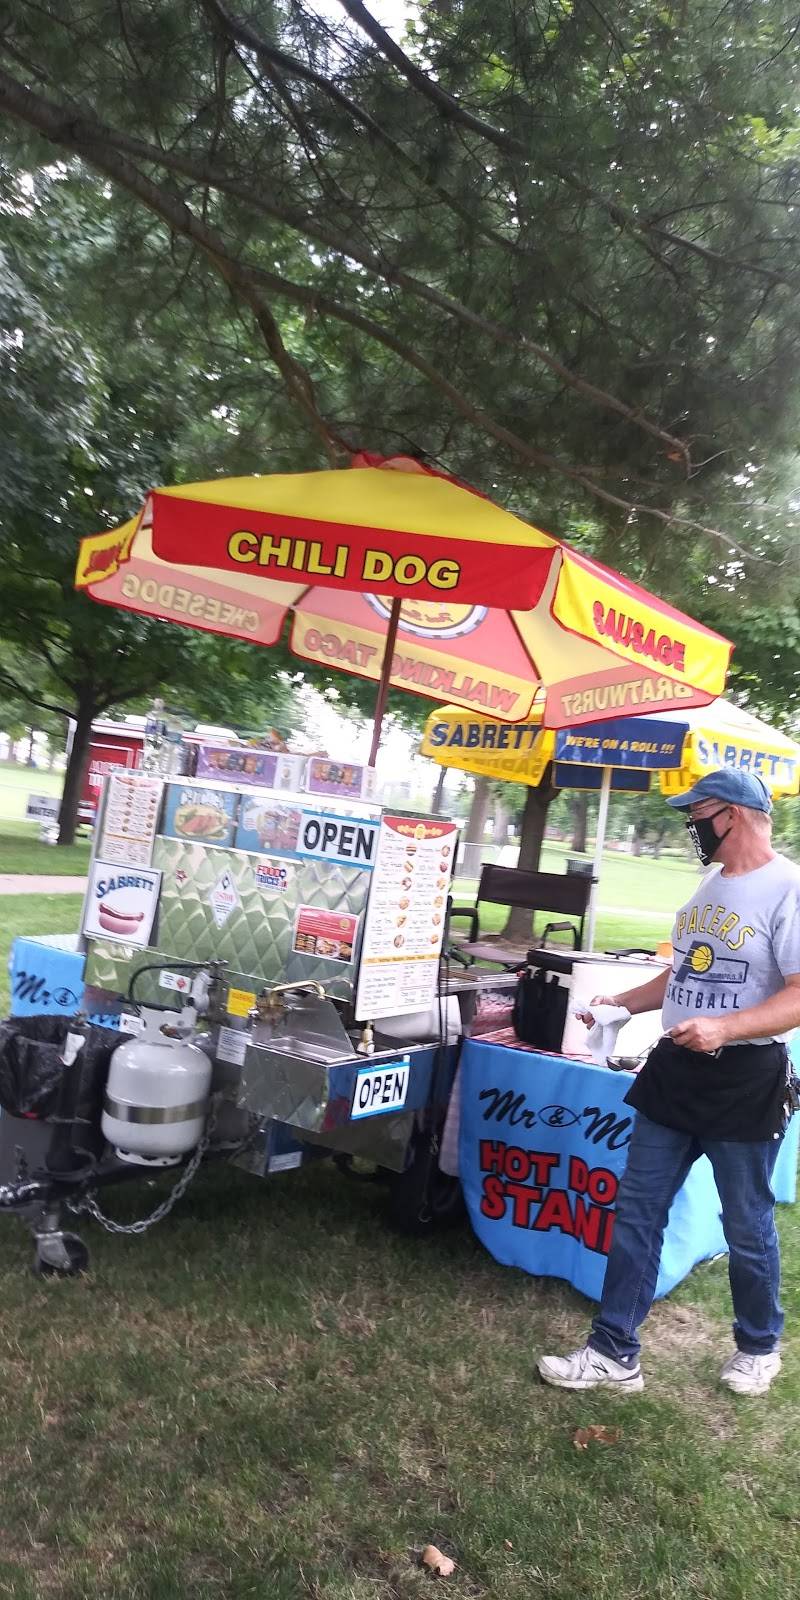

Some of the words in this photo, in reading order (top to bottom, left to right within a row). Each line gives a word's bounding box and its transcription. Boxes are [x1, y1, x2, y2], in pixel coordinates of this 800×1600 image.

[228, 531, 349, 578] CHILI
[361, 549, 461, 589] DOG
[592, 600, 686, 673] SAUSAGE
[430, 723, 541, 749] SABRETT
[602, 739, 619, 750] ON
[620, 740, 630, 751] A
[630, 741, 658, 753] ROLL
[698, 740, 797, 781] SABRETT
[303, 819, 376, 861] OPEN
[95, 874, 154, 899] SABRETT
[677, 904, 756, 951] PACERS
[358, 1071, 408, 1109] OPEN
[479, 1087, 537, 1129] Mr
[583, 1105, 633, 1150] M
[479, 1139, 561, 1187] HOT
[568, 1154, 620, 1206] DO
